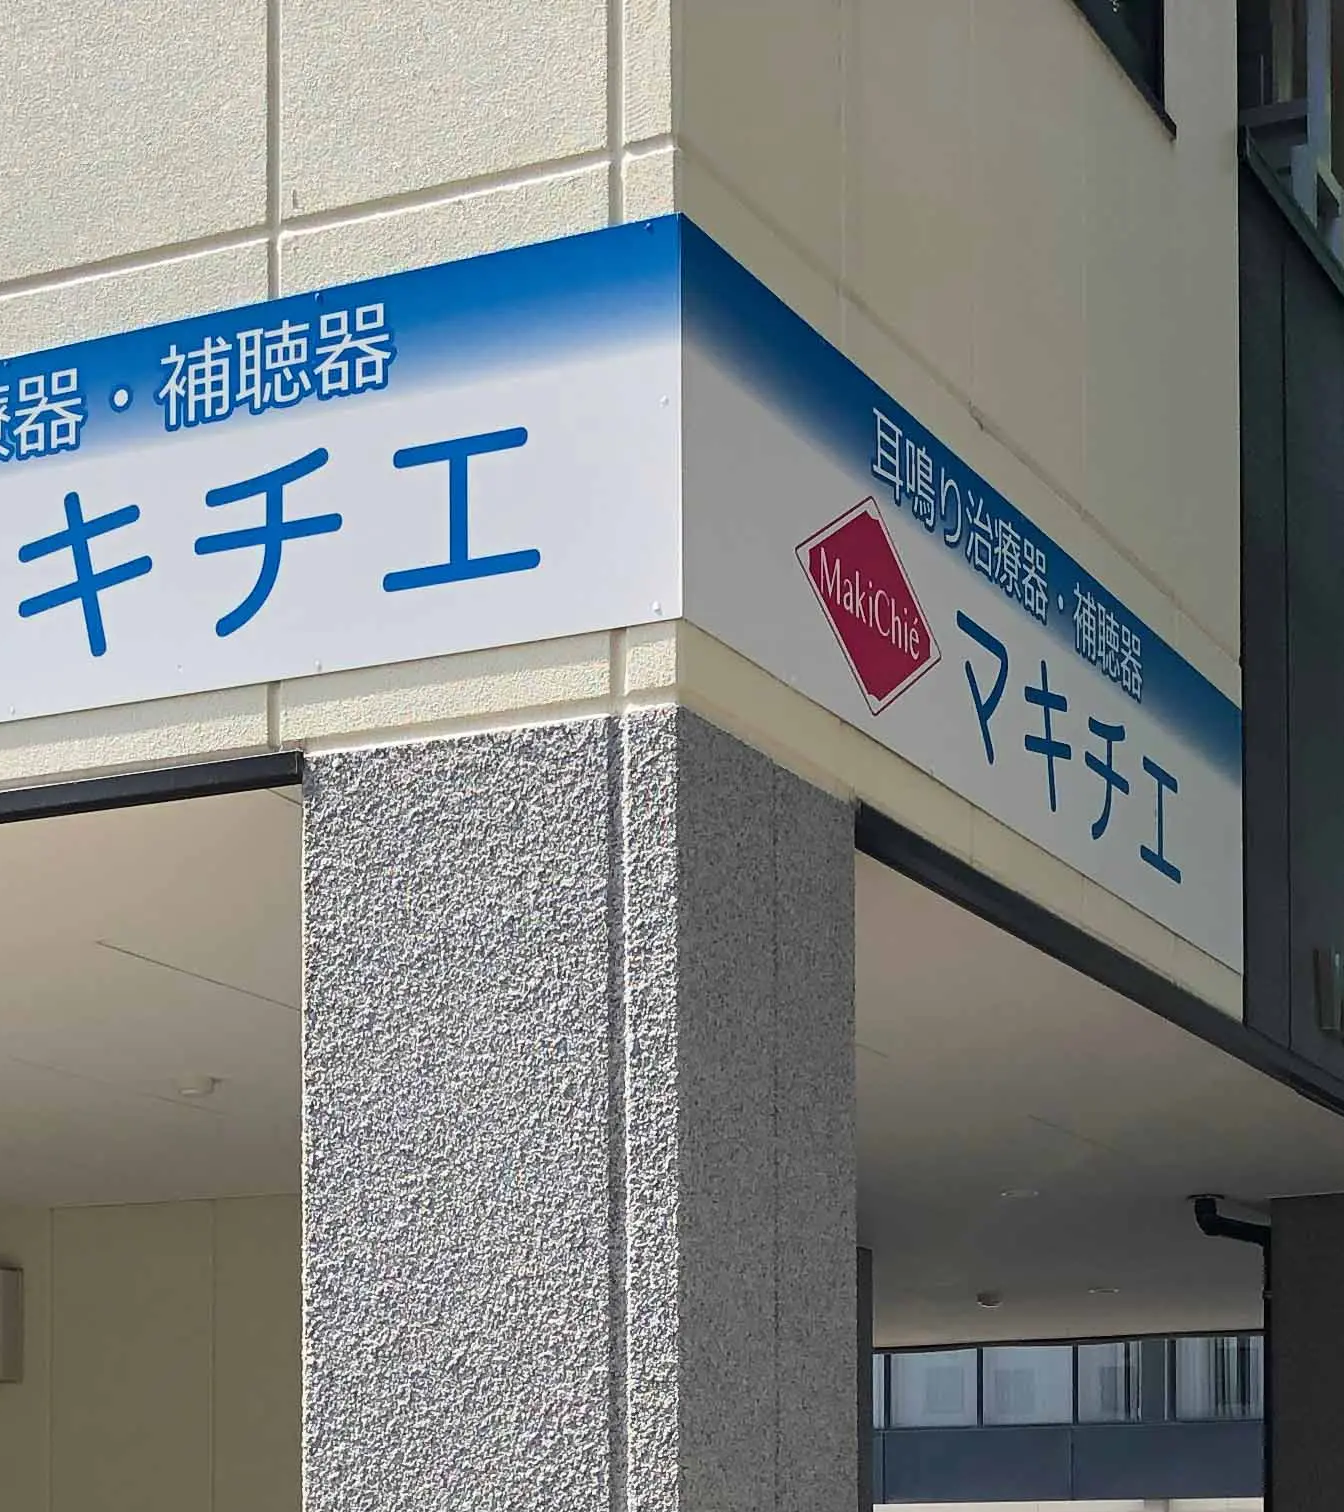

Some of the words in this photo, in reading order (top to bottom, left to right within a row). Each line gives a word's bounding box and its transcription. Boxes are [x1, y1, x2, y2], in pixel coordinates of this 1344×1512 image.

[819, 548, 921, 660] MakiChié
[872, 406, 1143, 702] 耳鳴り治療器・補聴器
[956, 610, 1182, 884] マキチエ
